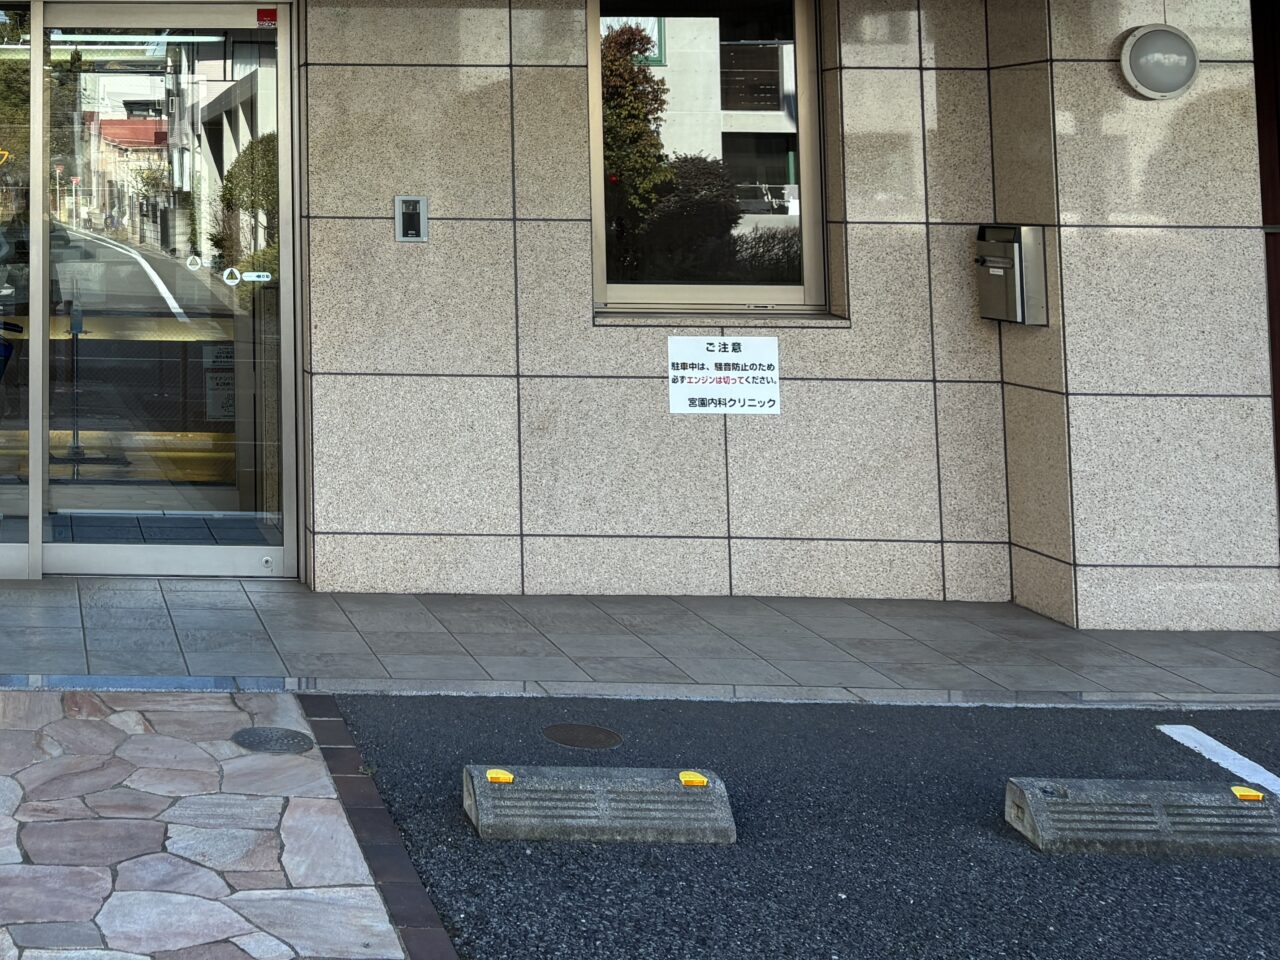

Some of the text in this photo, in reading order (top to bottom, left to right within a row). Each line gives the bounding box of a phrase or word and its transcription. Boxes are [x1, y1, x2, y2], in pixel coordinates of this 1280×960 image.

[705, 342, 743, 353] ご注意
[671, 362, 775, 372] 駐車中は、騒音防止のため
[671, 375, 777, 385] 必ずエンジンは切ってください。
[688, 397, 776, 408] 宮園内科クリニック
